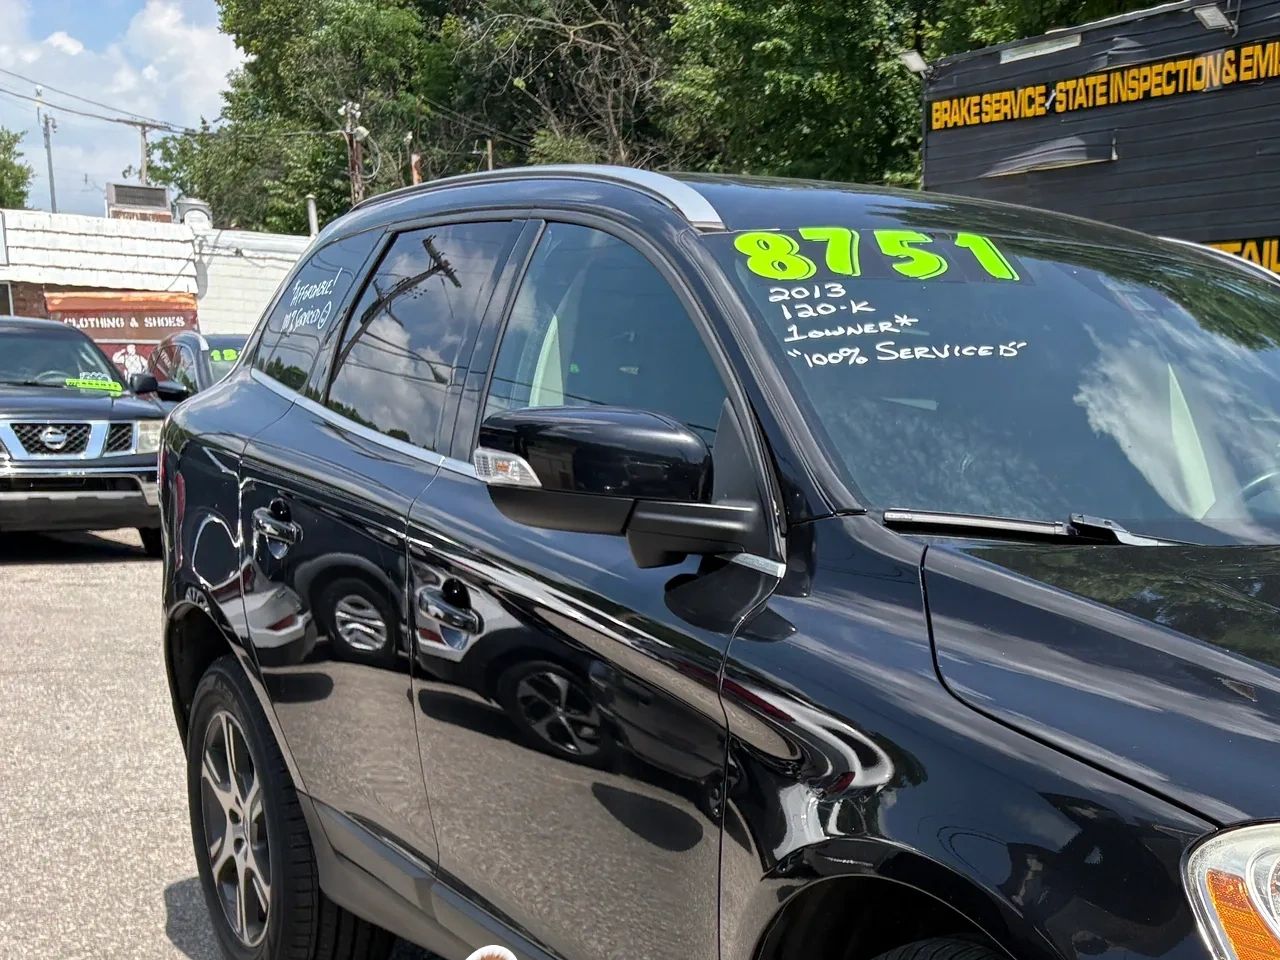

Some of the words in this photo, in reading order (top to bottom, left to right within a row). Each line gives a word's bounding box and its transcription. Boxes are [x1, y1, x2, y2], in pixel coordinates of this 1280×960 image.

[1055, 73, 1108, 113] STATE
[1110, 52, 1223, 103] INSPECTION
[1222, 50, 1237, 84] &
[932, 95, 980, 130] BRAKE
[982, 85, 1046, 123] SERVICE
[734, 227, 1020, 281] 8751
[768, 282, 847, 302] 2013
[64, 317, 125, 329] CLOTHING
[130, 317, 139, 328] &
[144, 316, 186, 328] SHOES
